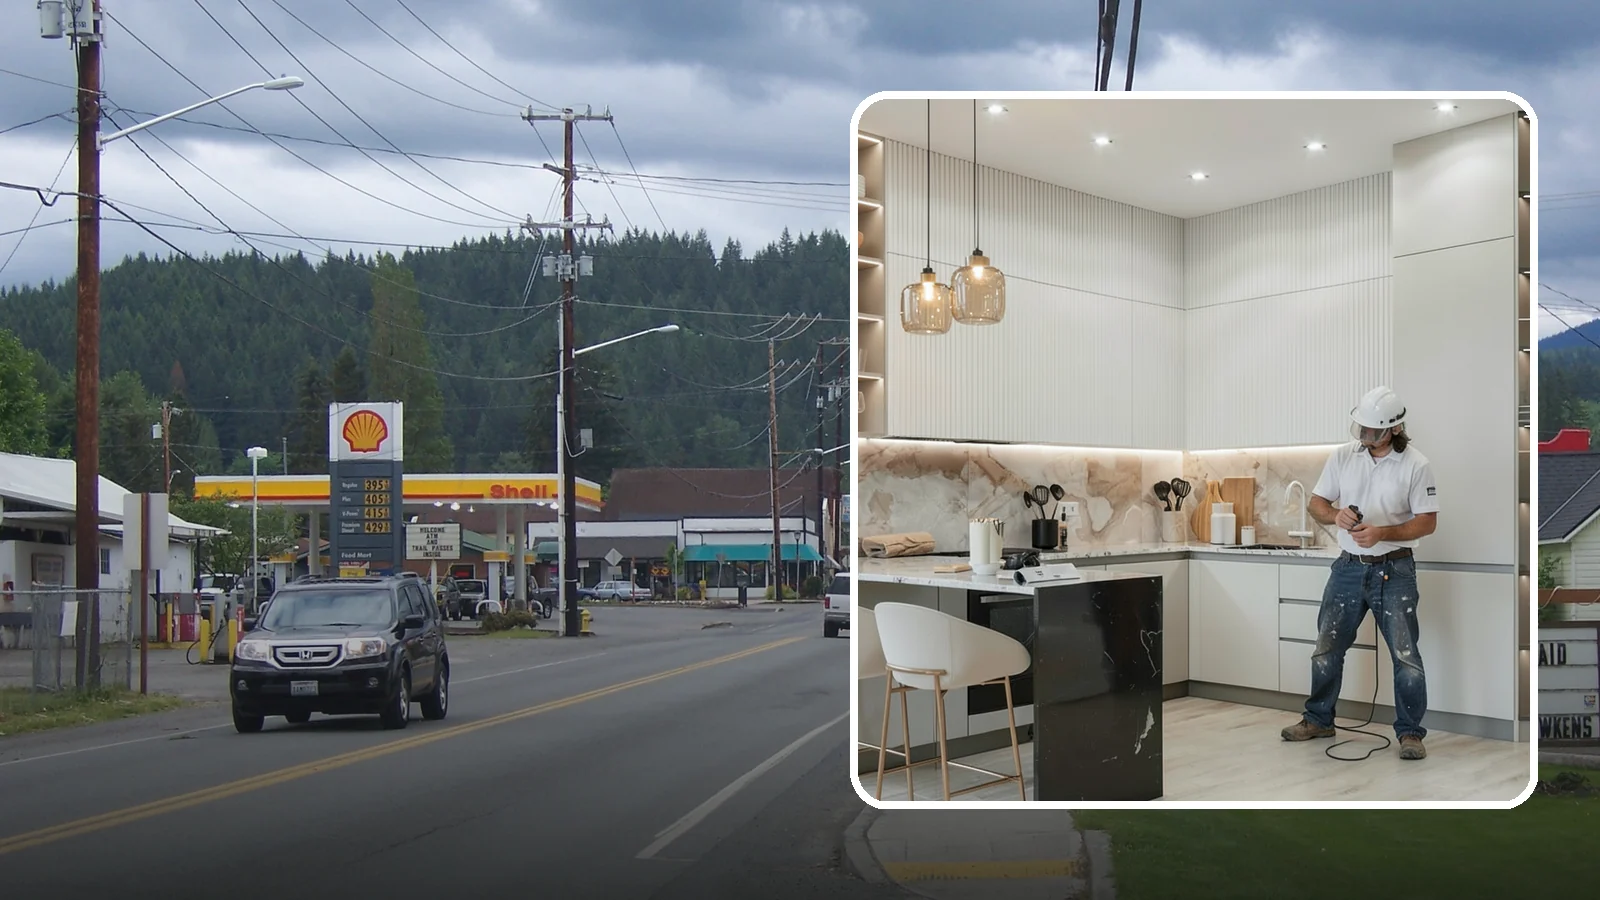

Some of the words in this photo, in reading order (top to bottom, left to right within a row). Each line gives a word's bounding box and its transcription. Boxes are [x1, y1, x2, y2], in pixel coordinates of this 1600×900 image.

[366, 480, 384, 490] 395
[490, 484, 547, 498] Shell
[366, 494, 384, 504] 405
[366, 508, 384, 518] 415
[366, 522, 384, 532] 429
